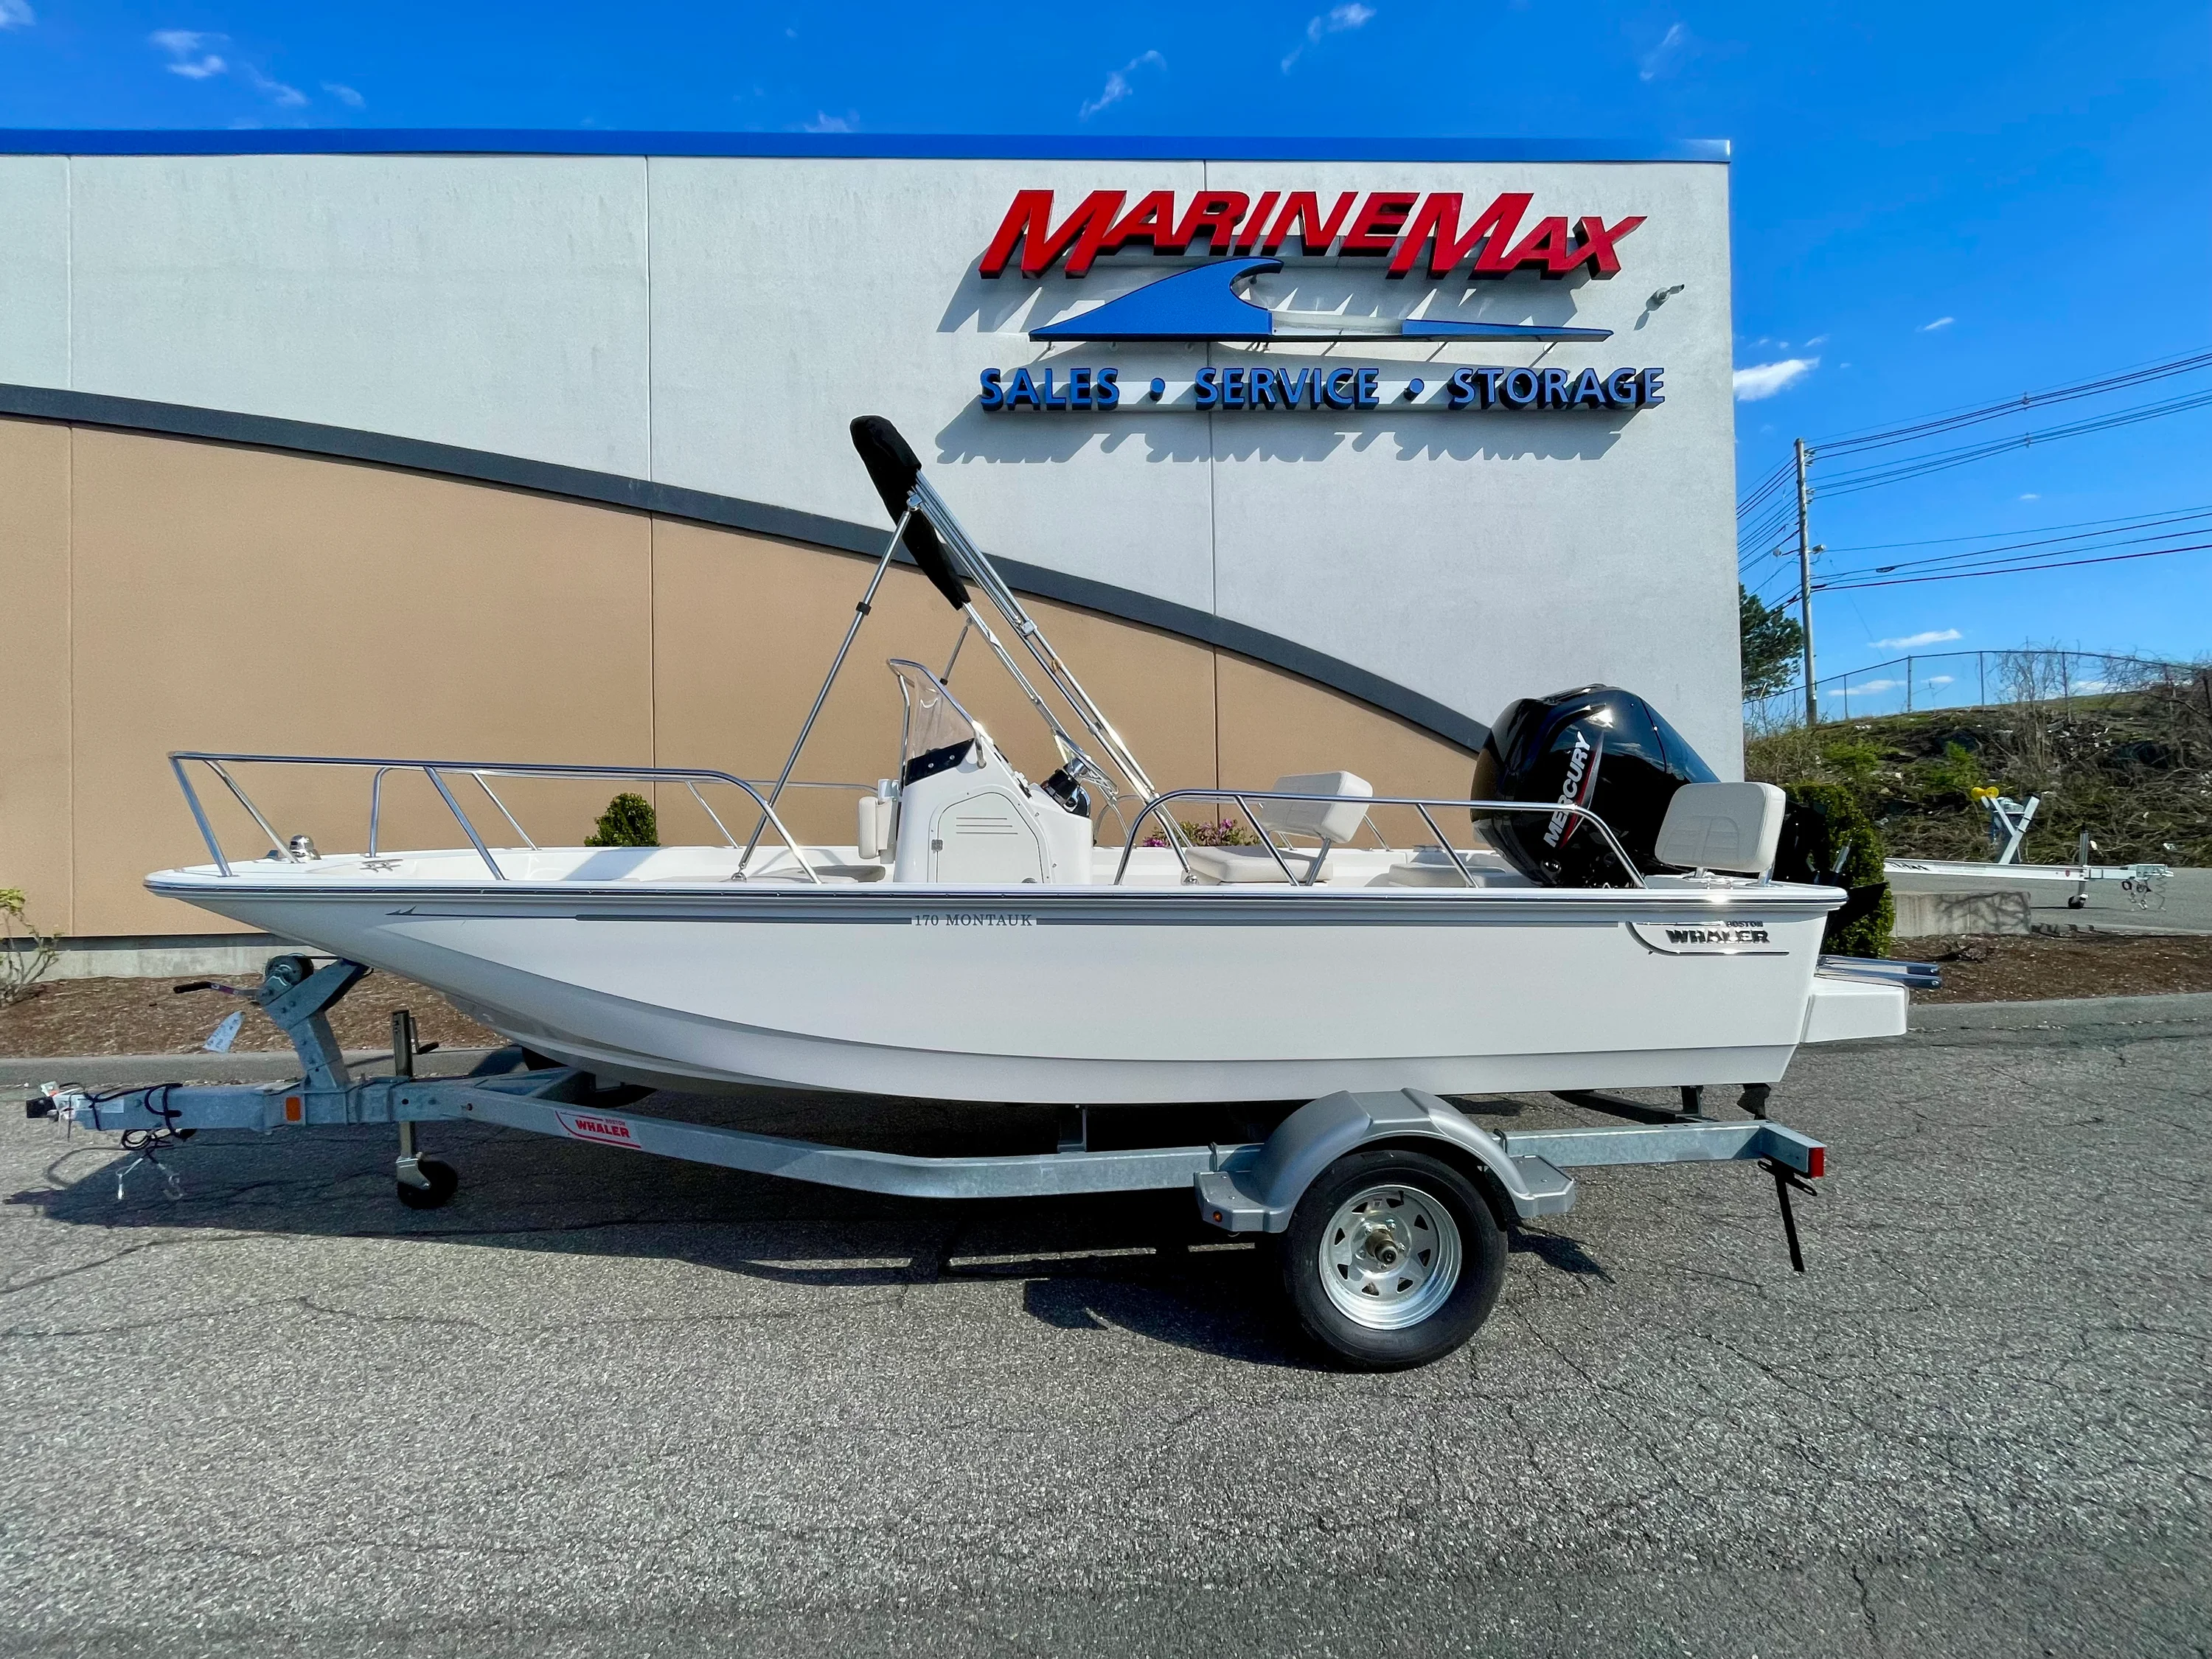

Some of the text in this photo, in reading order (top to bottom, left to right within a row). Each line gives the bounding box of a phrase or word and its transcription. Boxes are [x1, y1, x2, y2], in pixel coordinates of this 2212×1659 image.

[979, 367, 1666, 411] SALES SERVICE STORAGE
[1543, 731, 1590, 848] MERCURY
[914, 914, 1033, 926] 170 MONTAUK
[1665, 928, 1770, 944] WHALER
[574, 1119, 631, 1138] WHALER
